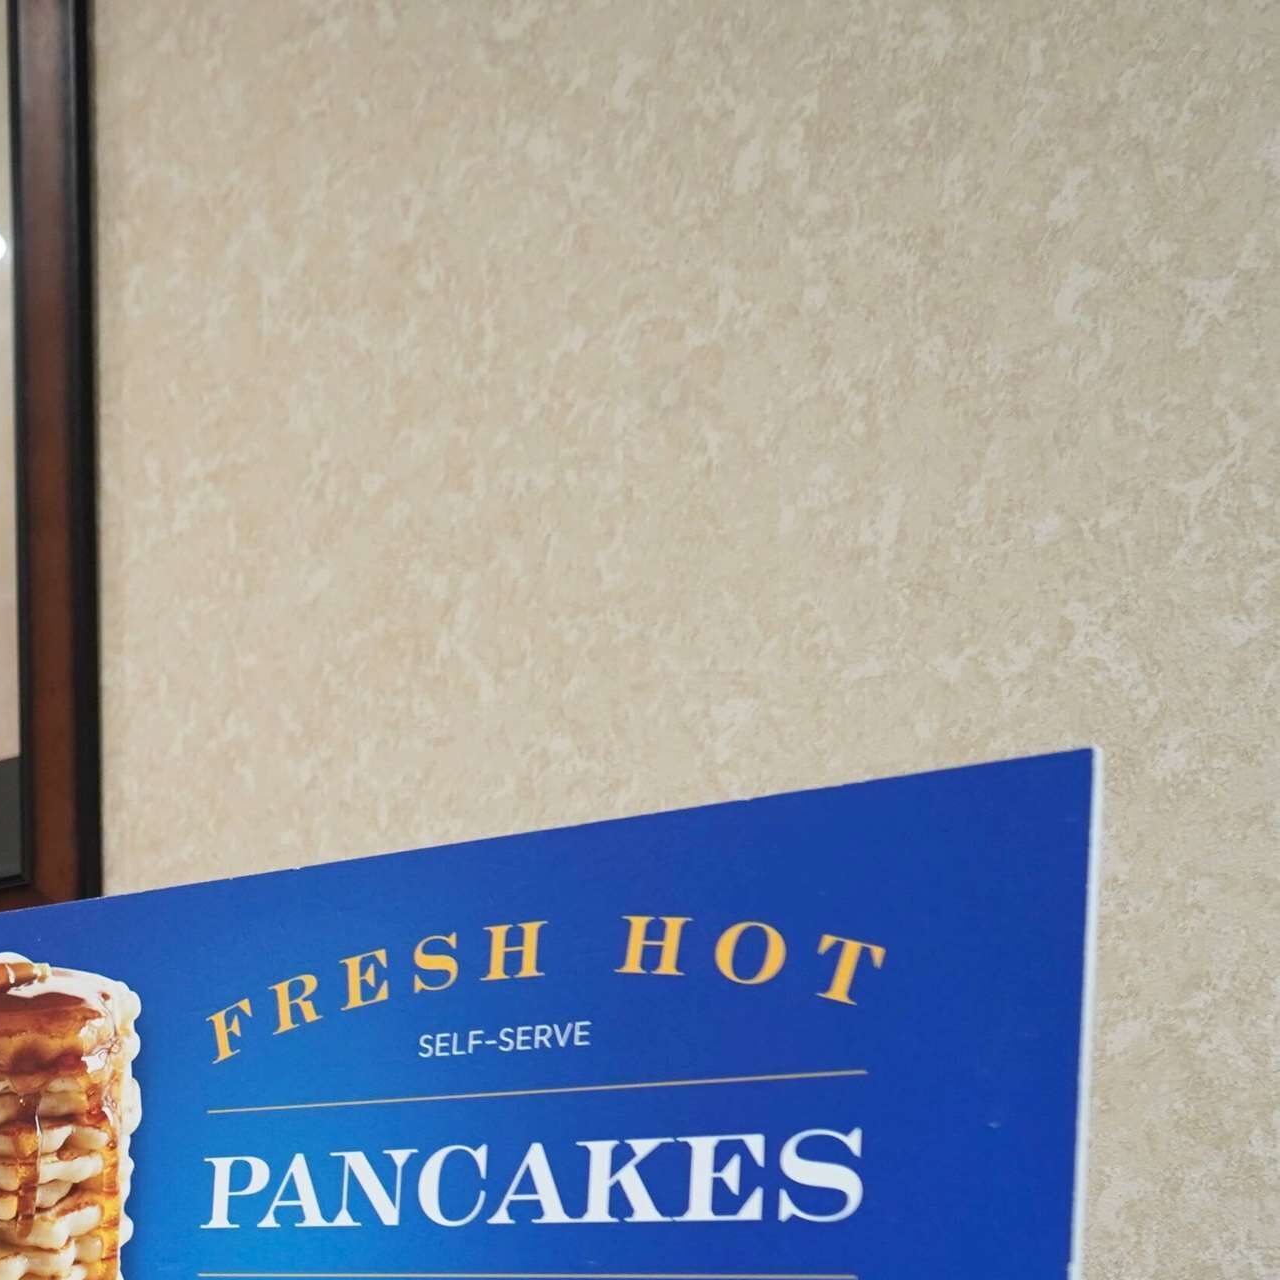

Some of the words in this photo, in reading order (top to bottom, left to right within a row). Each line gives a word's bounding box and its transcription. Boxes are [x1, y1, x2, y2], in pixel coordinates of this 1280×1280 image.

[206, 920, 548, 1063] FRESH
[614, 914, 886, 1004] HOT
[417, 1020, 592, 1059] SELF-SERVE
[199, 1127, 864, 1230] PANCAKES
